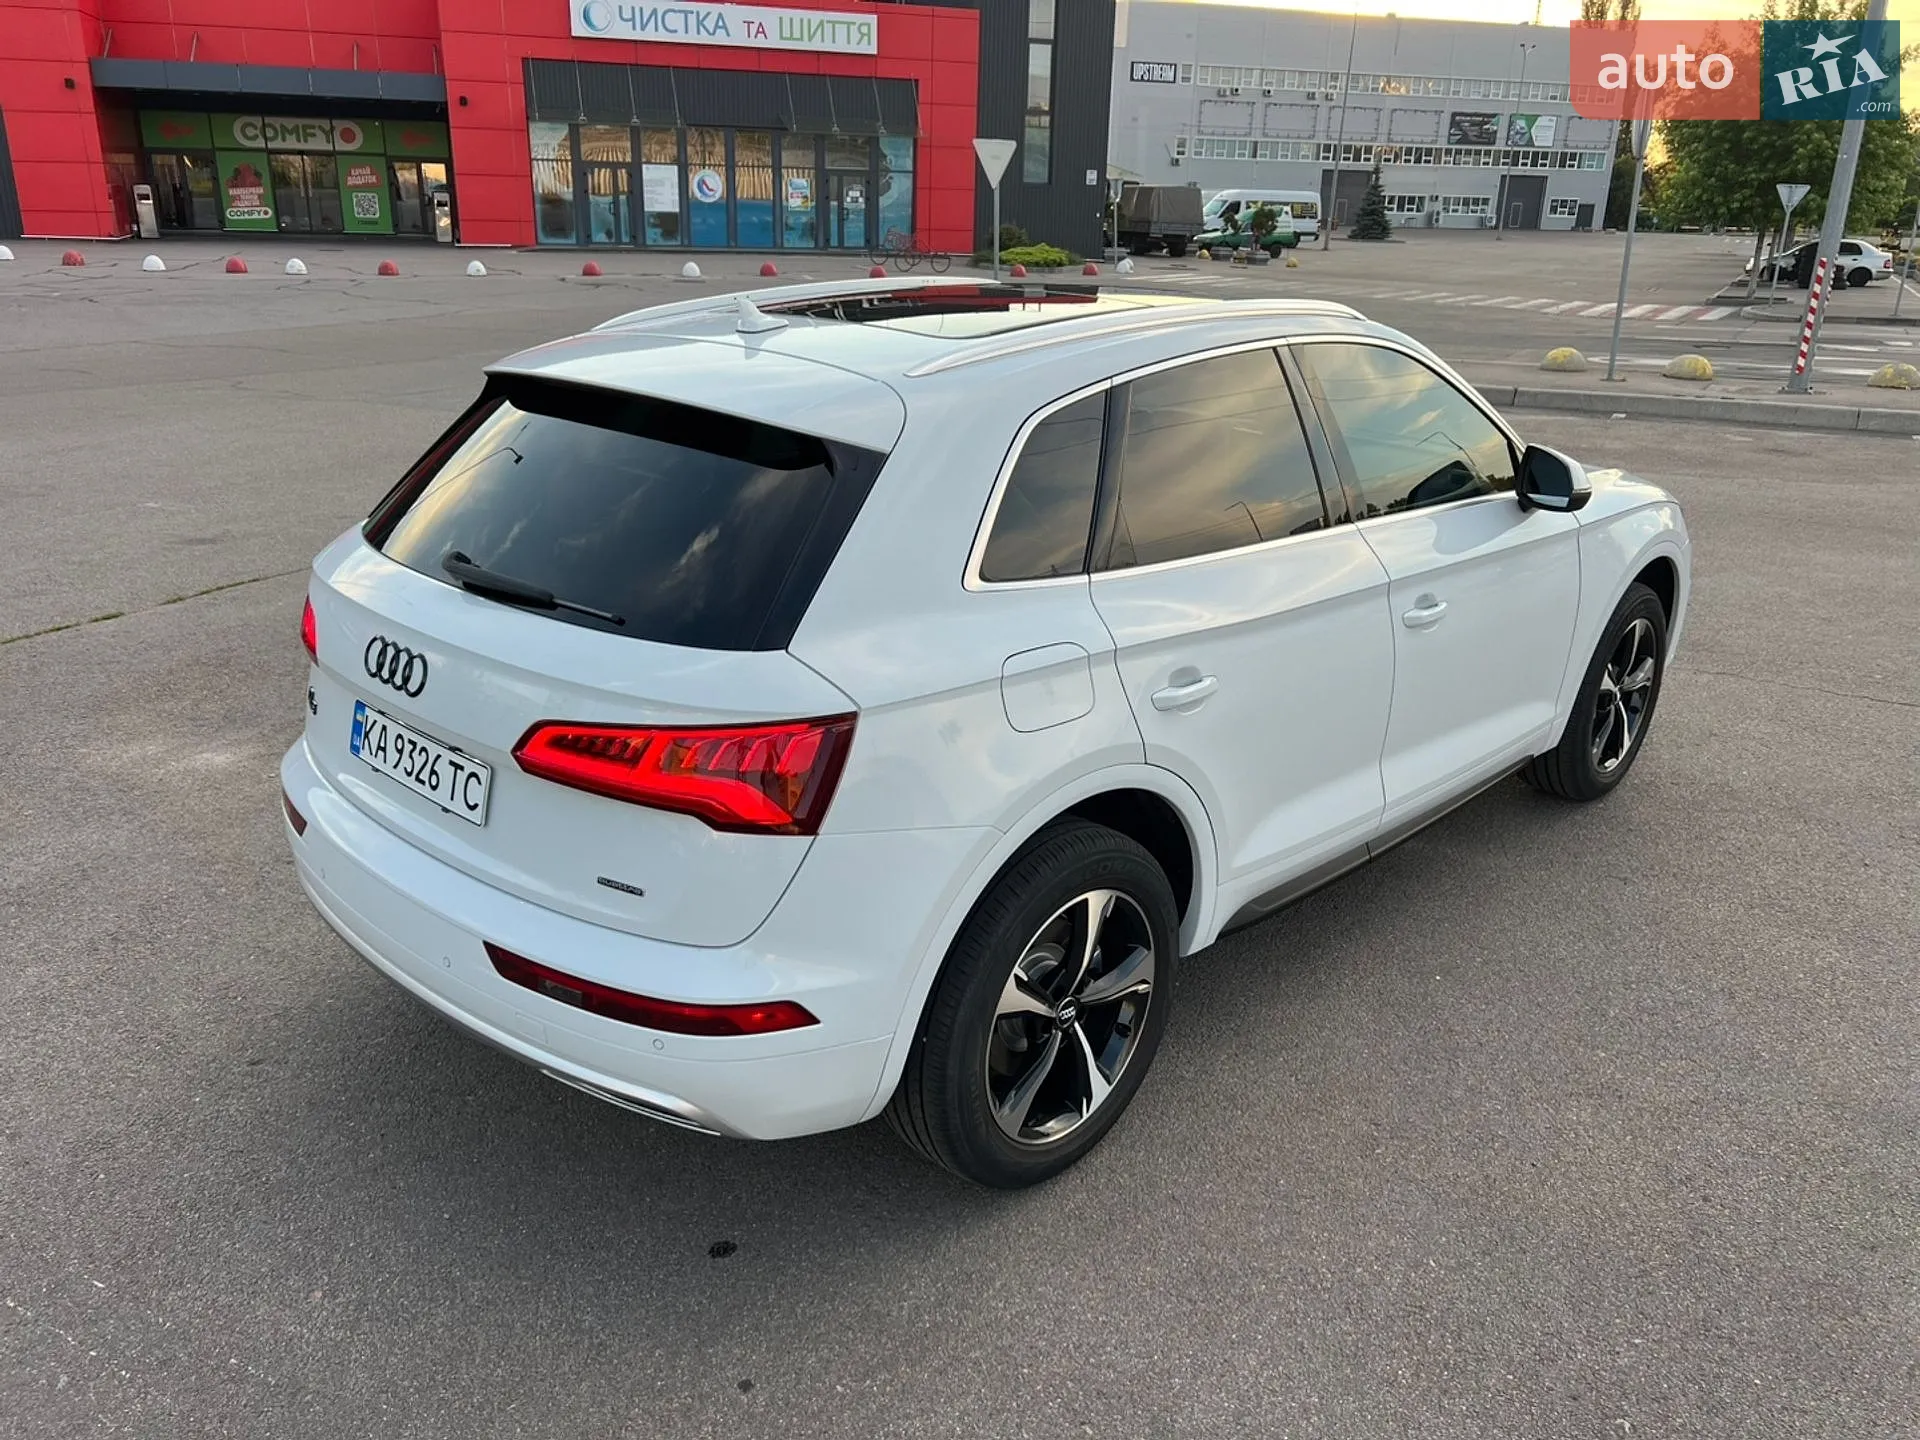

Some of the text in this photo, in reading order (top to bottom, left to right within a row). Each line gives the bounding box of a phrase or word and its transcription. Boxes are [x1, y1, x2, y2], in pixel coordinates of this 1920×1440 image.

[618, 5, 872, 46] ЧИСТКА ТА ШИТТЯ
[1133, 63, 1175, 81] UPSTREAM
[240, 121, 336, 144] COMFY
[229, 209, 262, 217] COMFY
[361, 715, 482, 811] KA 9326 TC
